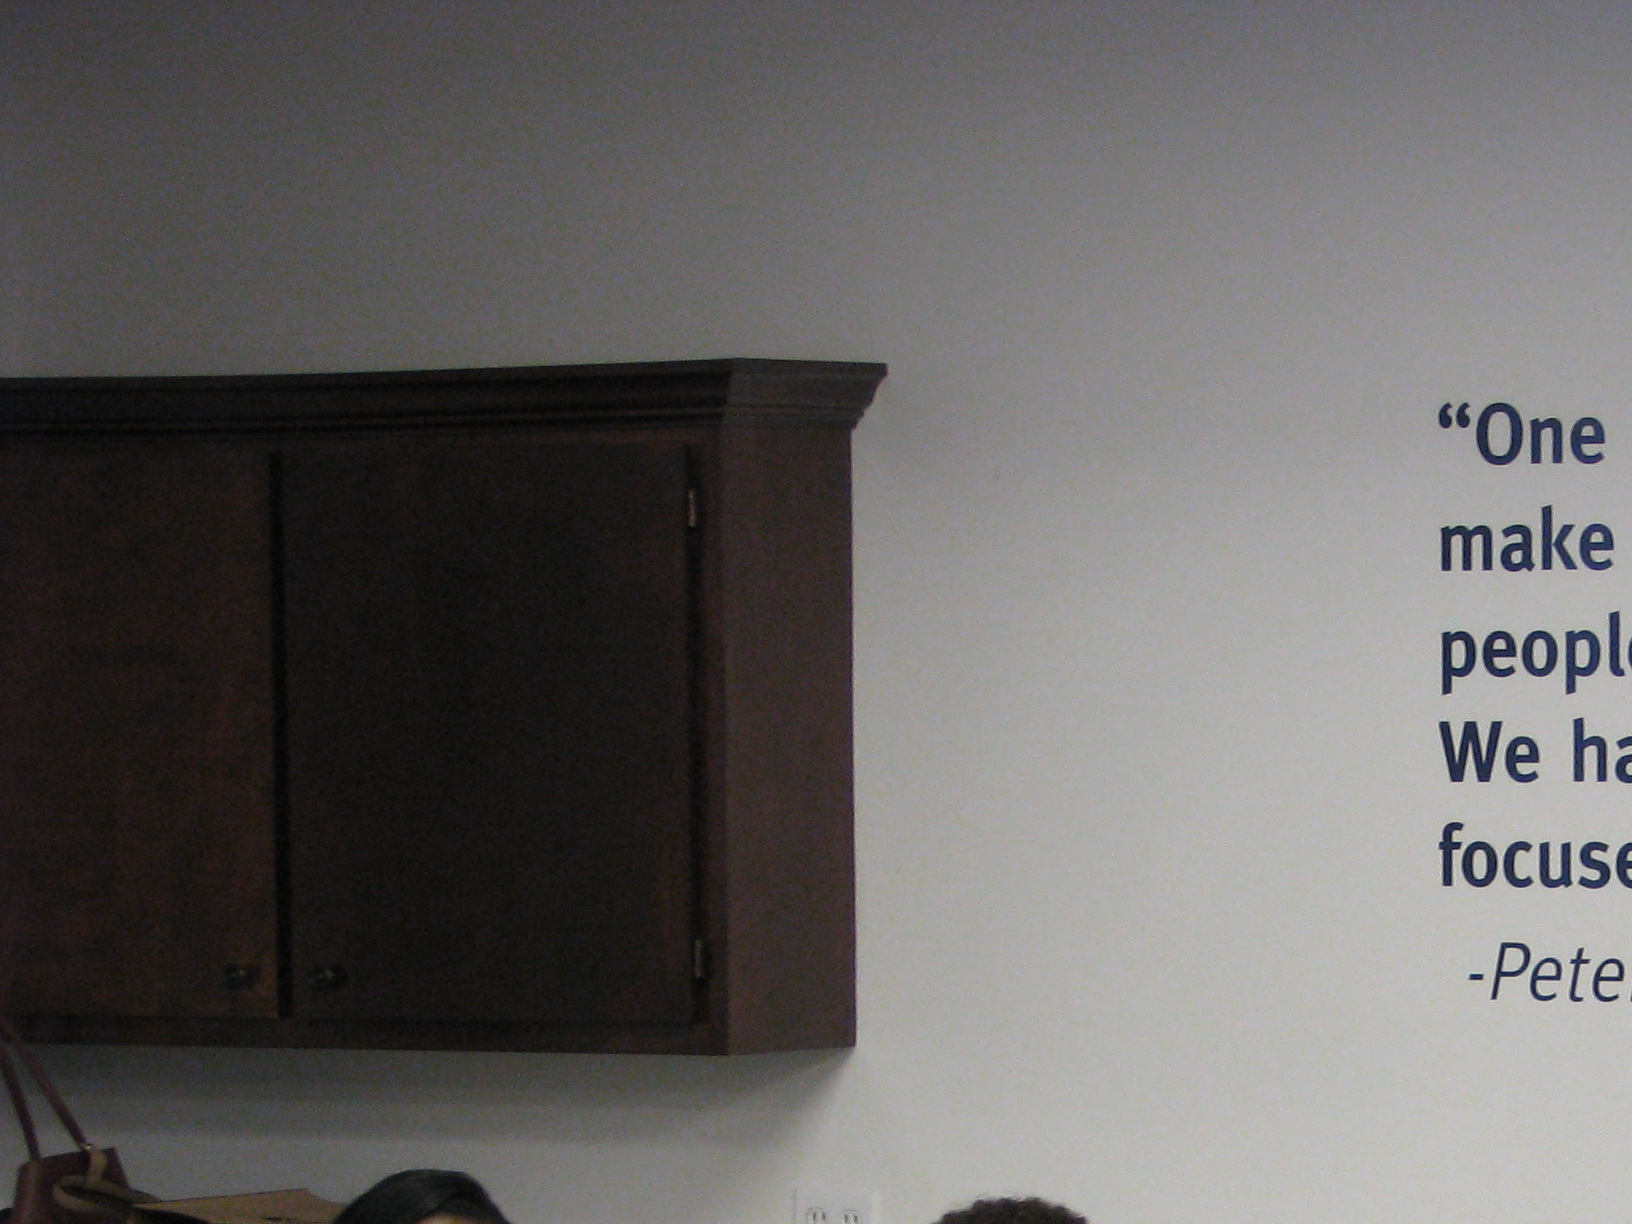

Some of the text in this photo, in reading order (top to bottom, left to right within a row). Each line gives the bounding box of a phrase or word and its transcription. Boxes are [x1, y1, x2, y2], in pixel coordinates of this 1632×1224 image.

[1438, 402, 1606, 465] “One
[1441, 505, 1614, 572] make
[1439, 721, 1539, 783] We
